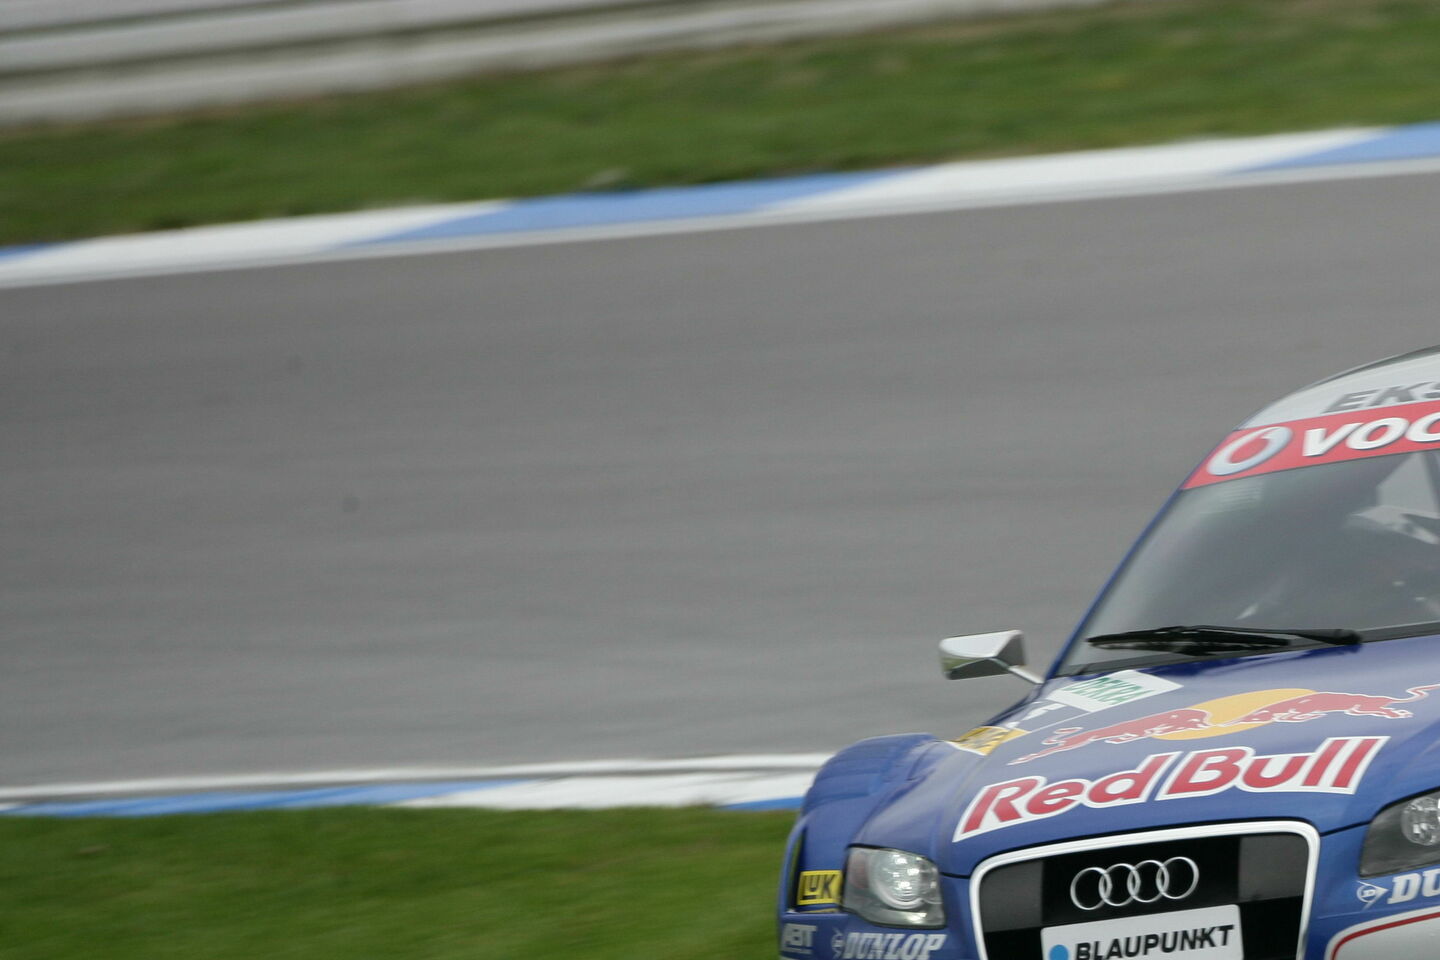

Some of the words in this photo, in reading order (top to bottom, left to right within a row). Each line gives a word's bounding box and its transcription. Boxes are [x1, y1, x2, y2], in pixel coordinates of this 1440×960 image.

[953, 751, 1182, 843] Red
[1155, 735, 1391, 801] Bull
[843, 932, 947, 960] DUNLOP
